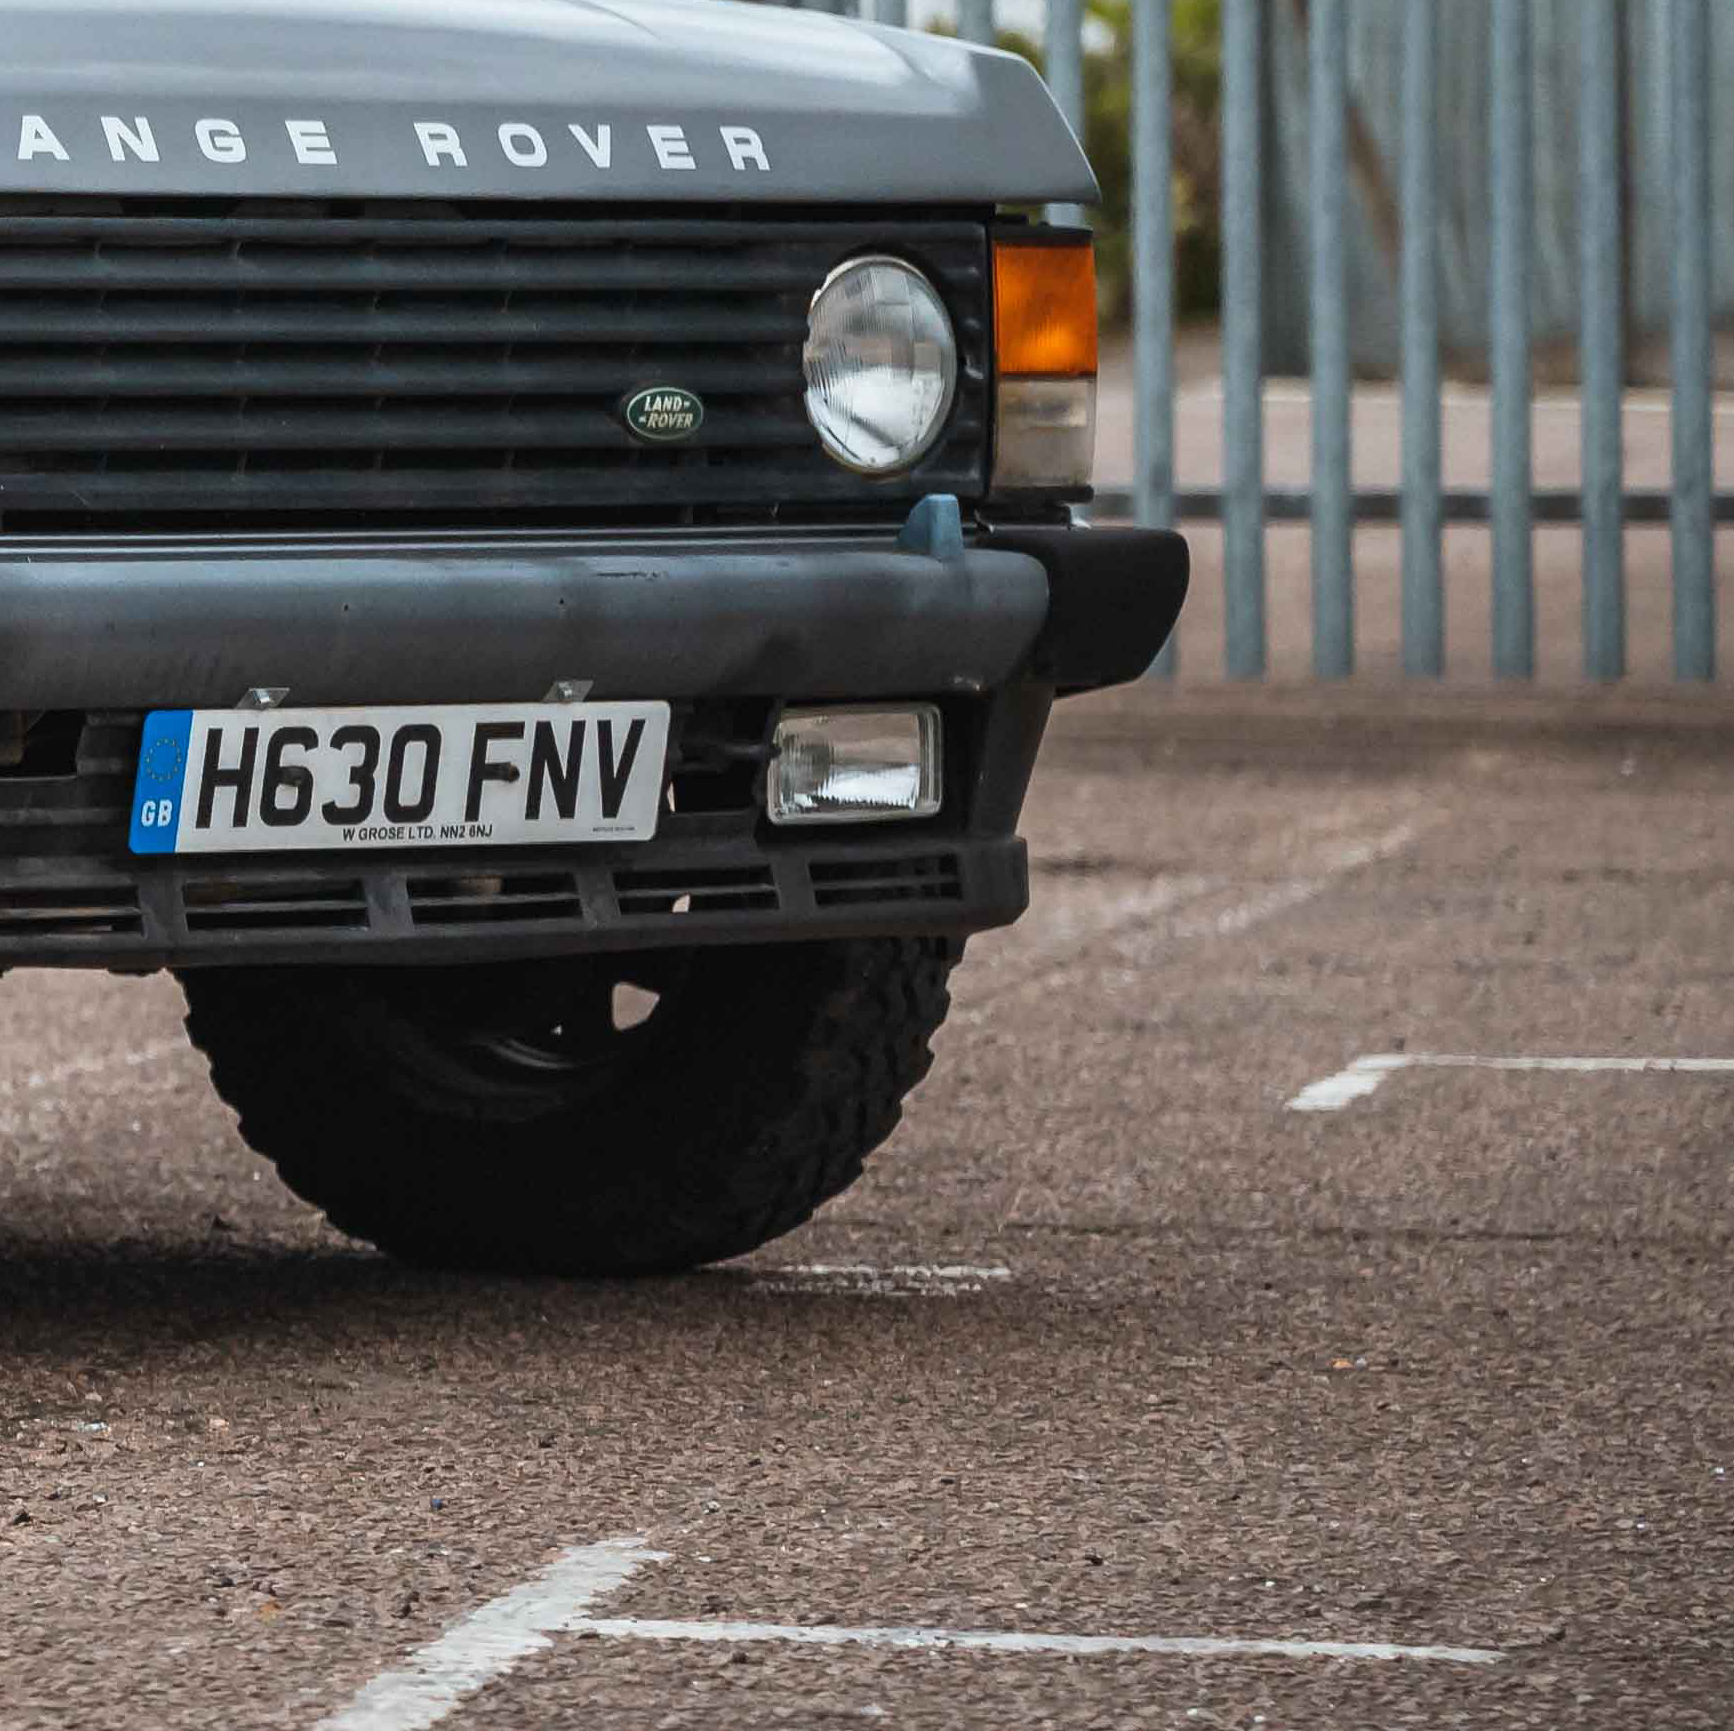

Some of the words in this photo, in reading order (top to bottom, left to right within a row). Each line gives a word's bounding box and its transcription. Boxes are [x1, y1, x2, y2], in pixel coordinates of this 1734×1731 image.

[412, 121, 771, 171] ROVER
[644, 394, 683, 412] LAND
[646, 412, 694, 429] ROVER
[194, 723, 443, 829] H630
[463, 718, 647, 823] FNV
[141, 799, 173, 827] GB
[343, 827, 355, 841] W
[358, 826, 405, 841] GROSE
[440, 825, 466, 839] NN2
